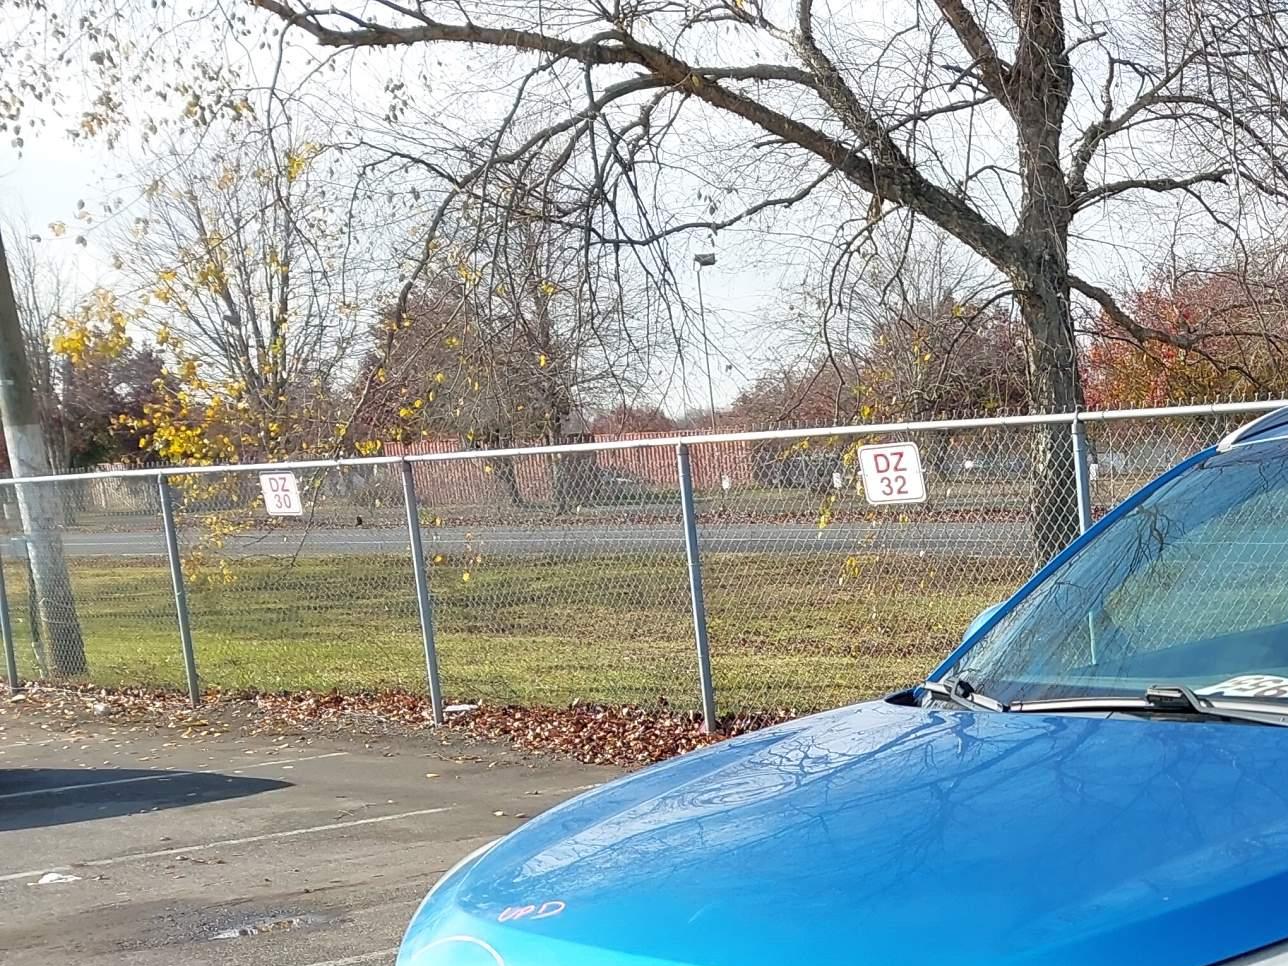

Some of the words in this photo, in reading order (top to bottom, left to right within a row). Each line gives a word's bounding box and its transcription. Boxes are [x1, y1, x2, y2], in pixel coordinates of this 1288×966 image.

[873, 451, 907, 473] DZ
[268, 477, 290, 492] DZ
[880, 475, 909, 496] 32
[274, 494, 292, 509] 30
